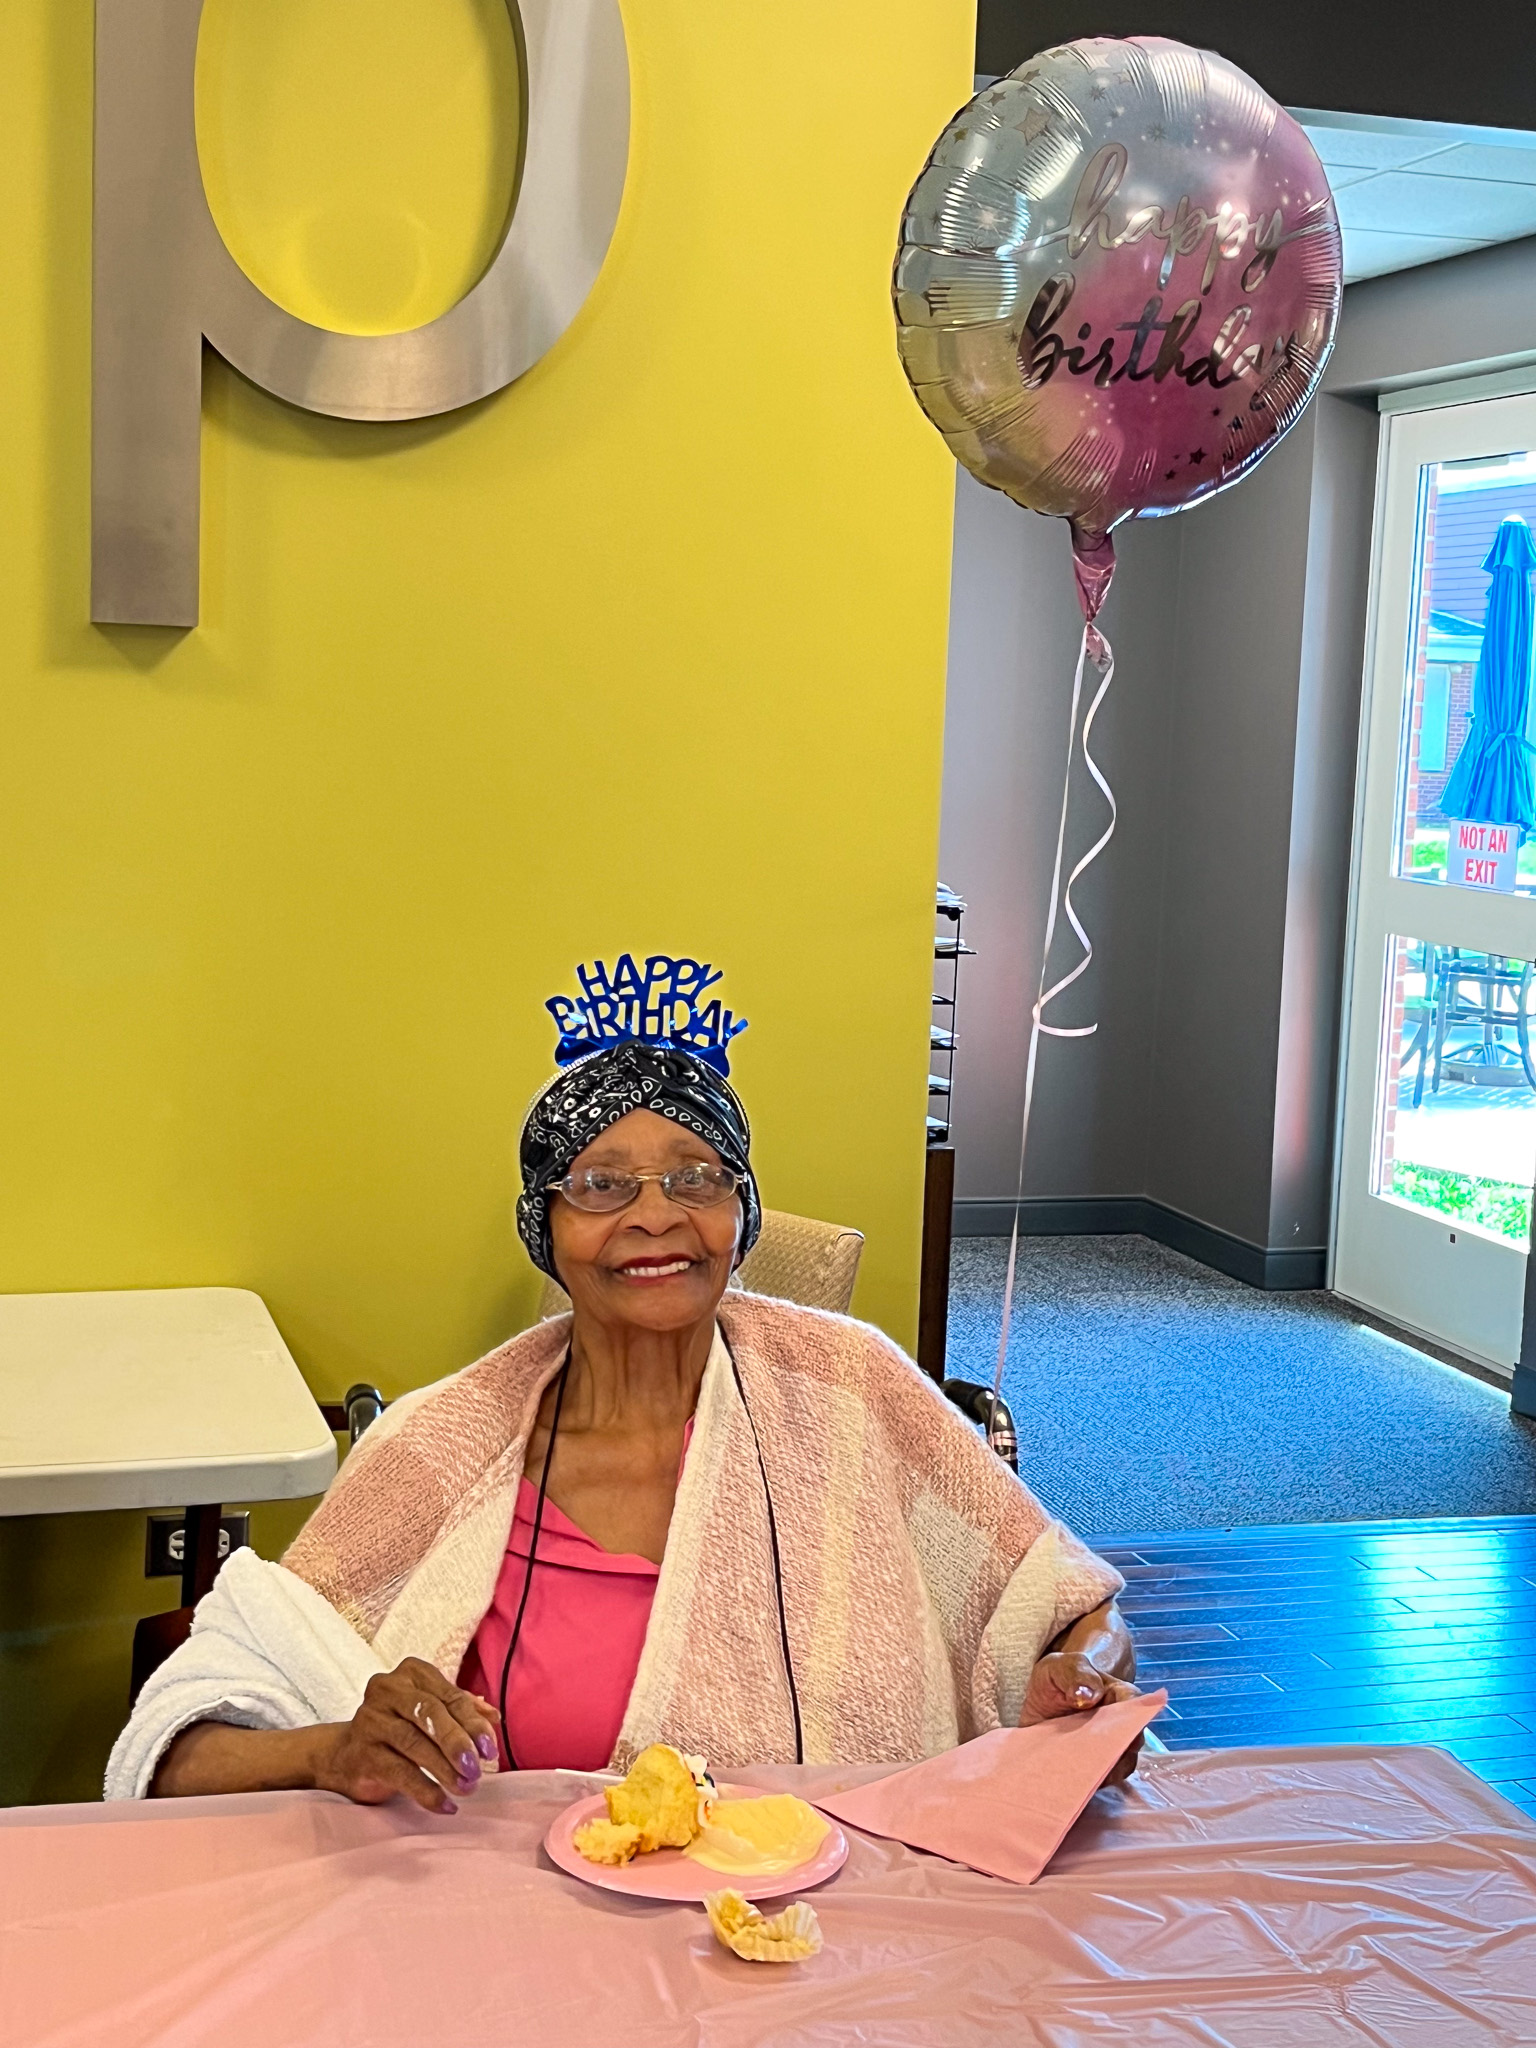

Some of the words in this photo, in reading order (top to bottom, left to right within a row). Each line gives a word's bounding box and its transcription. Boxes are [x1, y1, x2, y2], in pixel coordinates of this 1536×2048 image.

[1050, 142, 1300, 297] happy
[1459, 825, 1486, 851] NOT
[1487, 829, 1508, 854] AN
[1465, 858, 1498, 885] EXIT
[576, 953, 723, 1004] HAPPY
[545, 995, 749, 1049] BIRTHDAY
